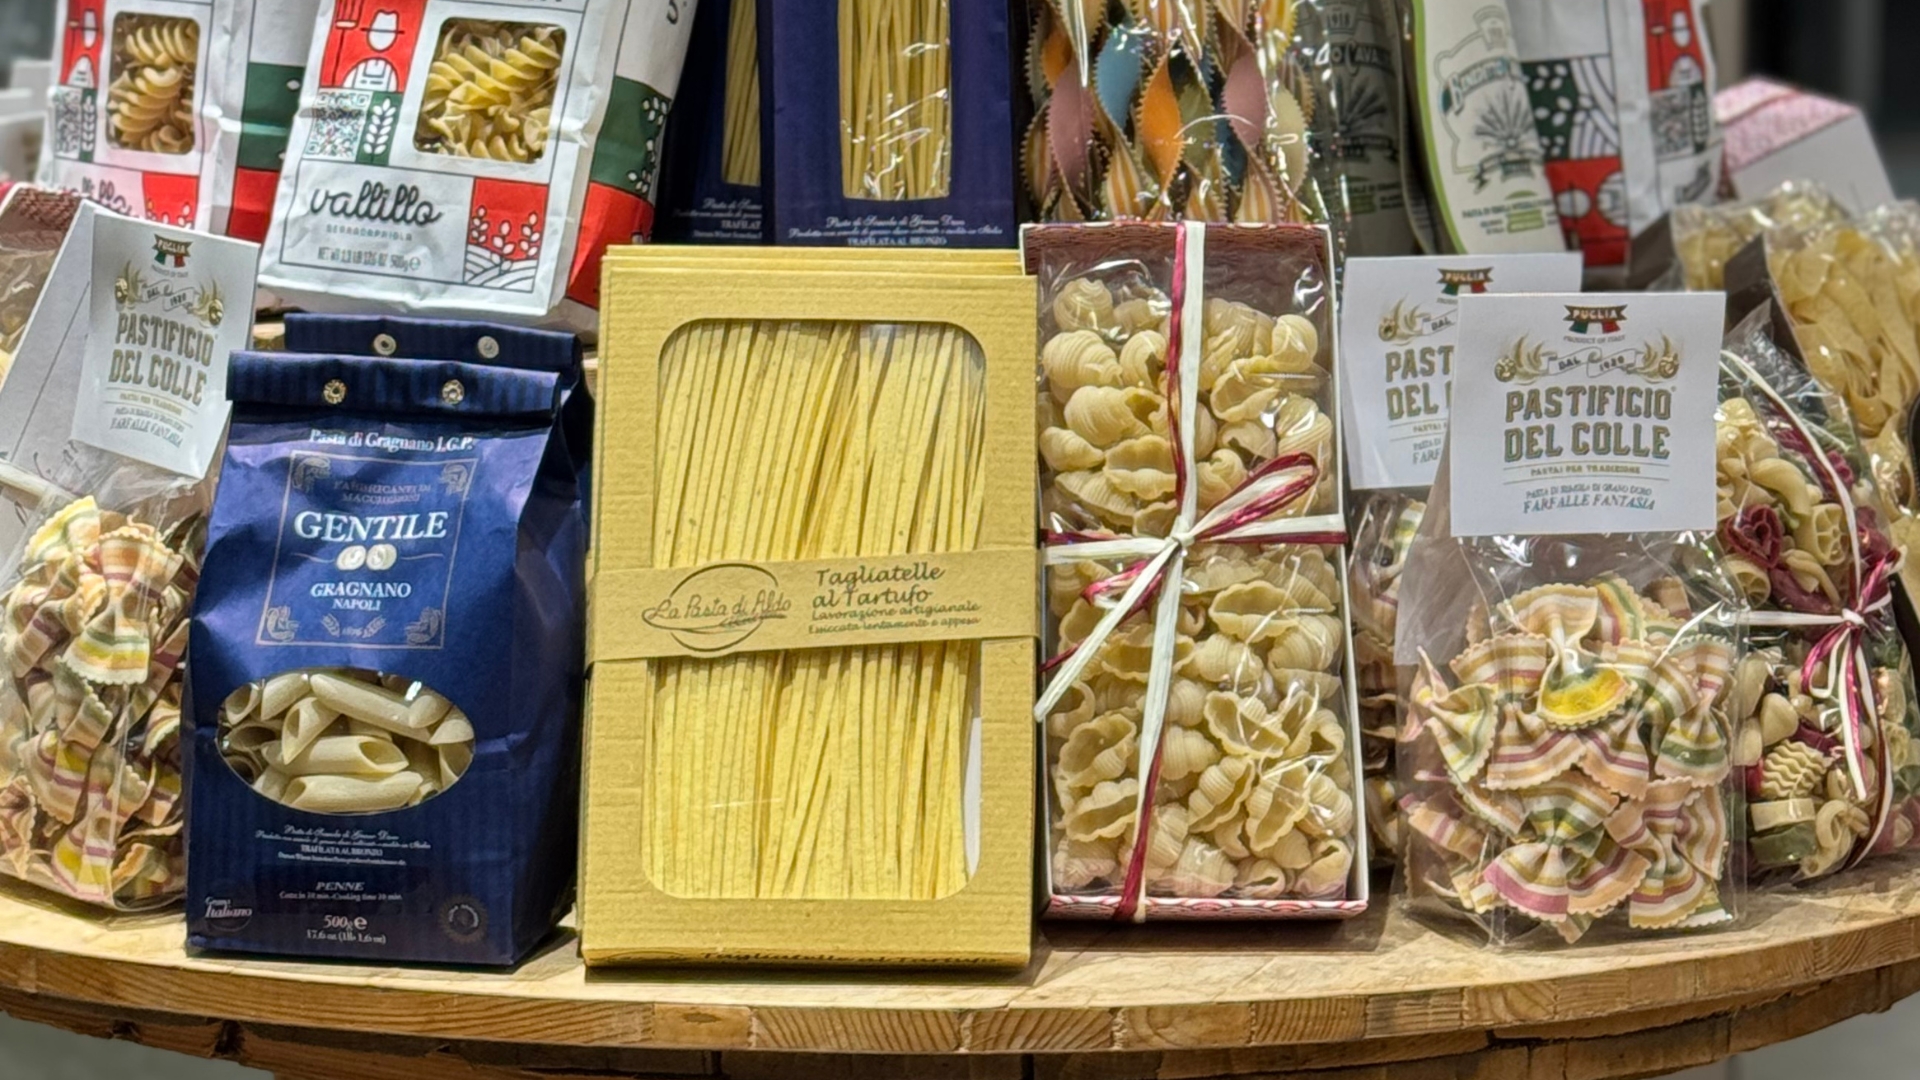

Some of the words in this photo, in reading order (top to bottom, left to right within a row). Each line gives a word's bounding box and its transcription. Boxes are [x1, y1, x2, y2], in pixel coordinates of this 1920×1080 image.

[309, 179, 444, 226] vallillo
[157, 239, 186, 255] PUGLIA
[1431, 316, 1452, 331] DAL
[1572, 308, 1619, 320] PUGLIA
[115, 313, 214, 367] PASTIFICIO
[1558, 355, 1581, 371] DAL
[108, 348, 144, 385] DEL
[147, 354, 208, 407] COLLE
[1386, 382, 1439, 421] DEL
[1505, 385, 1672, 424] PASTIFICIO
[309, 428, 347, 446] Pasta
[348, 431, 363, 447] di
[365, 432, 435, 453] Gragnano
[1504, 423, 1563, 463] DEL
[1571, 421, 1671, 461] COLLE
[1530, 466, 1563, 477] PASTAI
[1565, 464, 1583, 474] PER
[1586, 464, 1641, 475] TRADIZIONE
[1523, 493, 1591, 514] FARFALLE
[1592, 493, 1656, 511] FANTASIA
[294, 510, 449, 541] GENTILE
[817, 561, 946, 591] Tagliatelle
[310, 581, 412, 599] GRAGNANO
[812, 589, 840, 609] al
[843, 583, 934, 607] Tartufo
[332, 598, 382, 612] NAPOLI
[648, 598, 681, 621] La
[684, 593, 728, 619] Pasta
[731, 594, 749, 616] di
[751, 589, 792, 614] Aldo
[811, 606, 897, 622] Lavorazione
[899, 600, 983, 617] artigianale
[808, 622, 862, 635] Essiccata
[863, 618, 930, 631] lentamente
[931, 619, 939, 627] e
[940, 616, 981, 630] appesa
[315, 881, 365, 892] PENNE
[204, 902, 253, 919] Italiano
